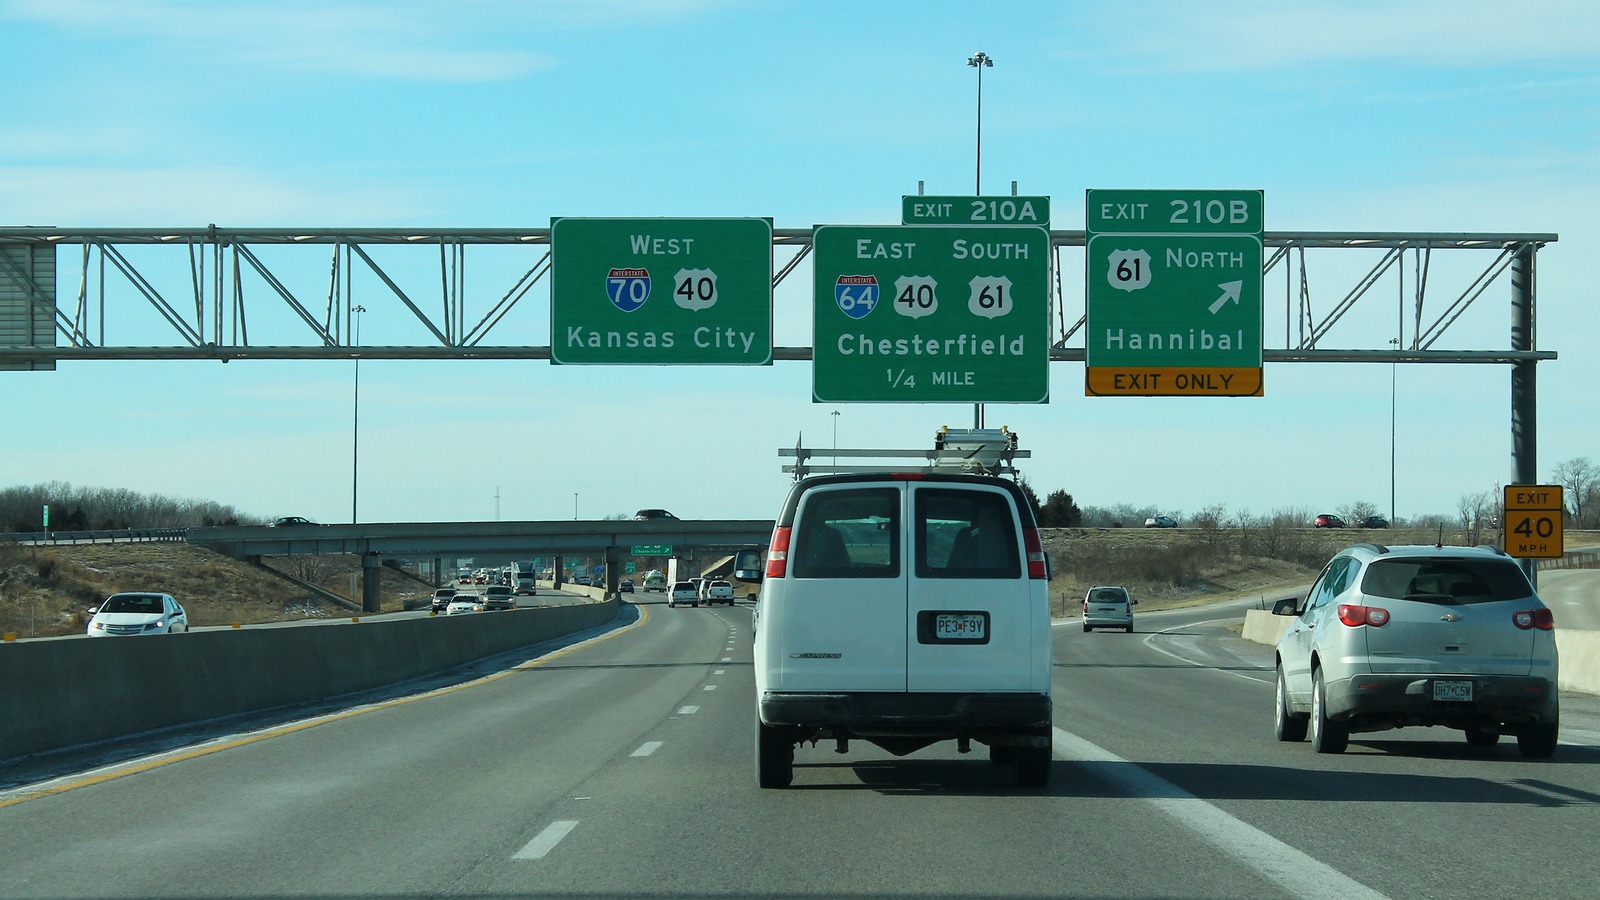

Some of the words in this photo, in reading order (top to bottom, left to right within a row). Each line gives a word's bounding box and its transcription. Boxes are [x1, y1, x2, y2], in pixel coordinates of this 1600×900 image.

[914, 203, 952, 218] EXIT
[970, 201, 1037, 221] 210A
[1102, 204, 1148, 220] EXIT
[1170, 200, 1248, 224] 210B
[630, 236, 694, 255] WEST
[856, 240, 916, 259] EAST
[952, 240, 1028, 260] SOUTH
[1166, 248, 1244, 268] NORTH
[1116, 258, 1140, 282] 61
[610, 279, 646, 302] 70
[677, 277, 714, 300] 40
[840, 286, 874, 310] 64
[898, 284, 934, 308] 40
[978, 285, 1002, 308] 61
[567, 327, 674, 348] Kansas
[693, 327, 755, 353] City
[838, 334, 1024, 356] Chesterfield
[1106, 328, 1242, 350] Hannibal
[886, 368, 916, 388] 1/4
[932, 372, 975, 386] MILE
[1114, 374, 1160, 390] EXIT
[1176, 374, 1234, 390] ONLY
[1517, 493, 1549, 504] EXIT
[1514, 517, 1554, 538] 40
[1519, 544, 1547, 552] MPH
